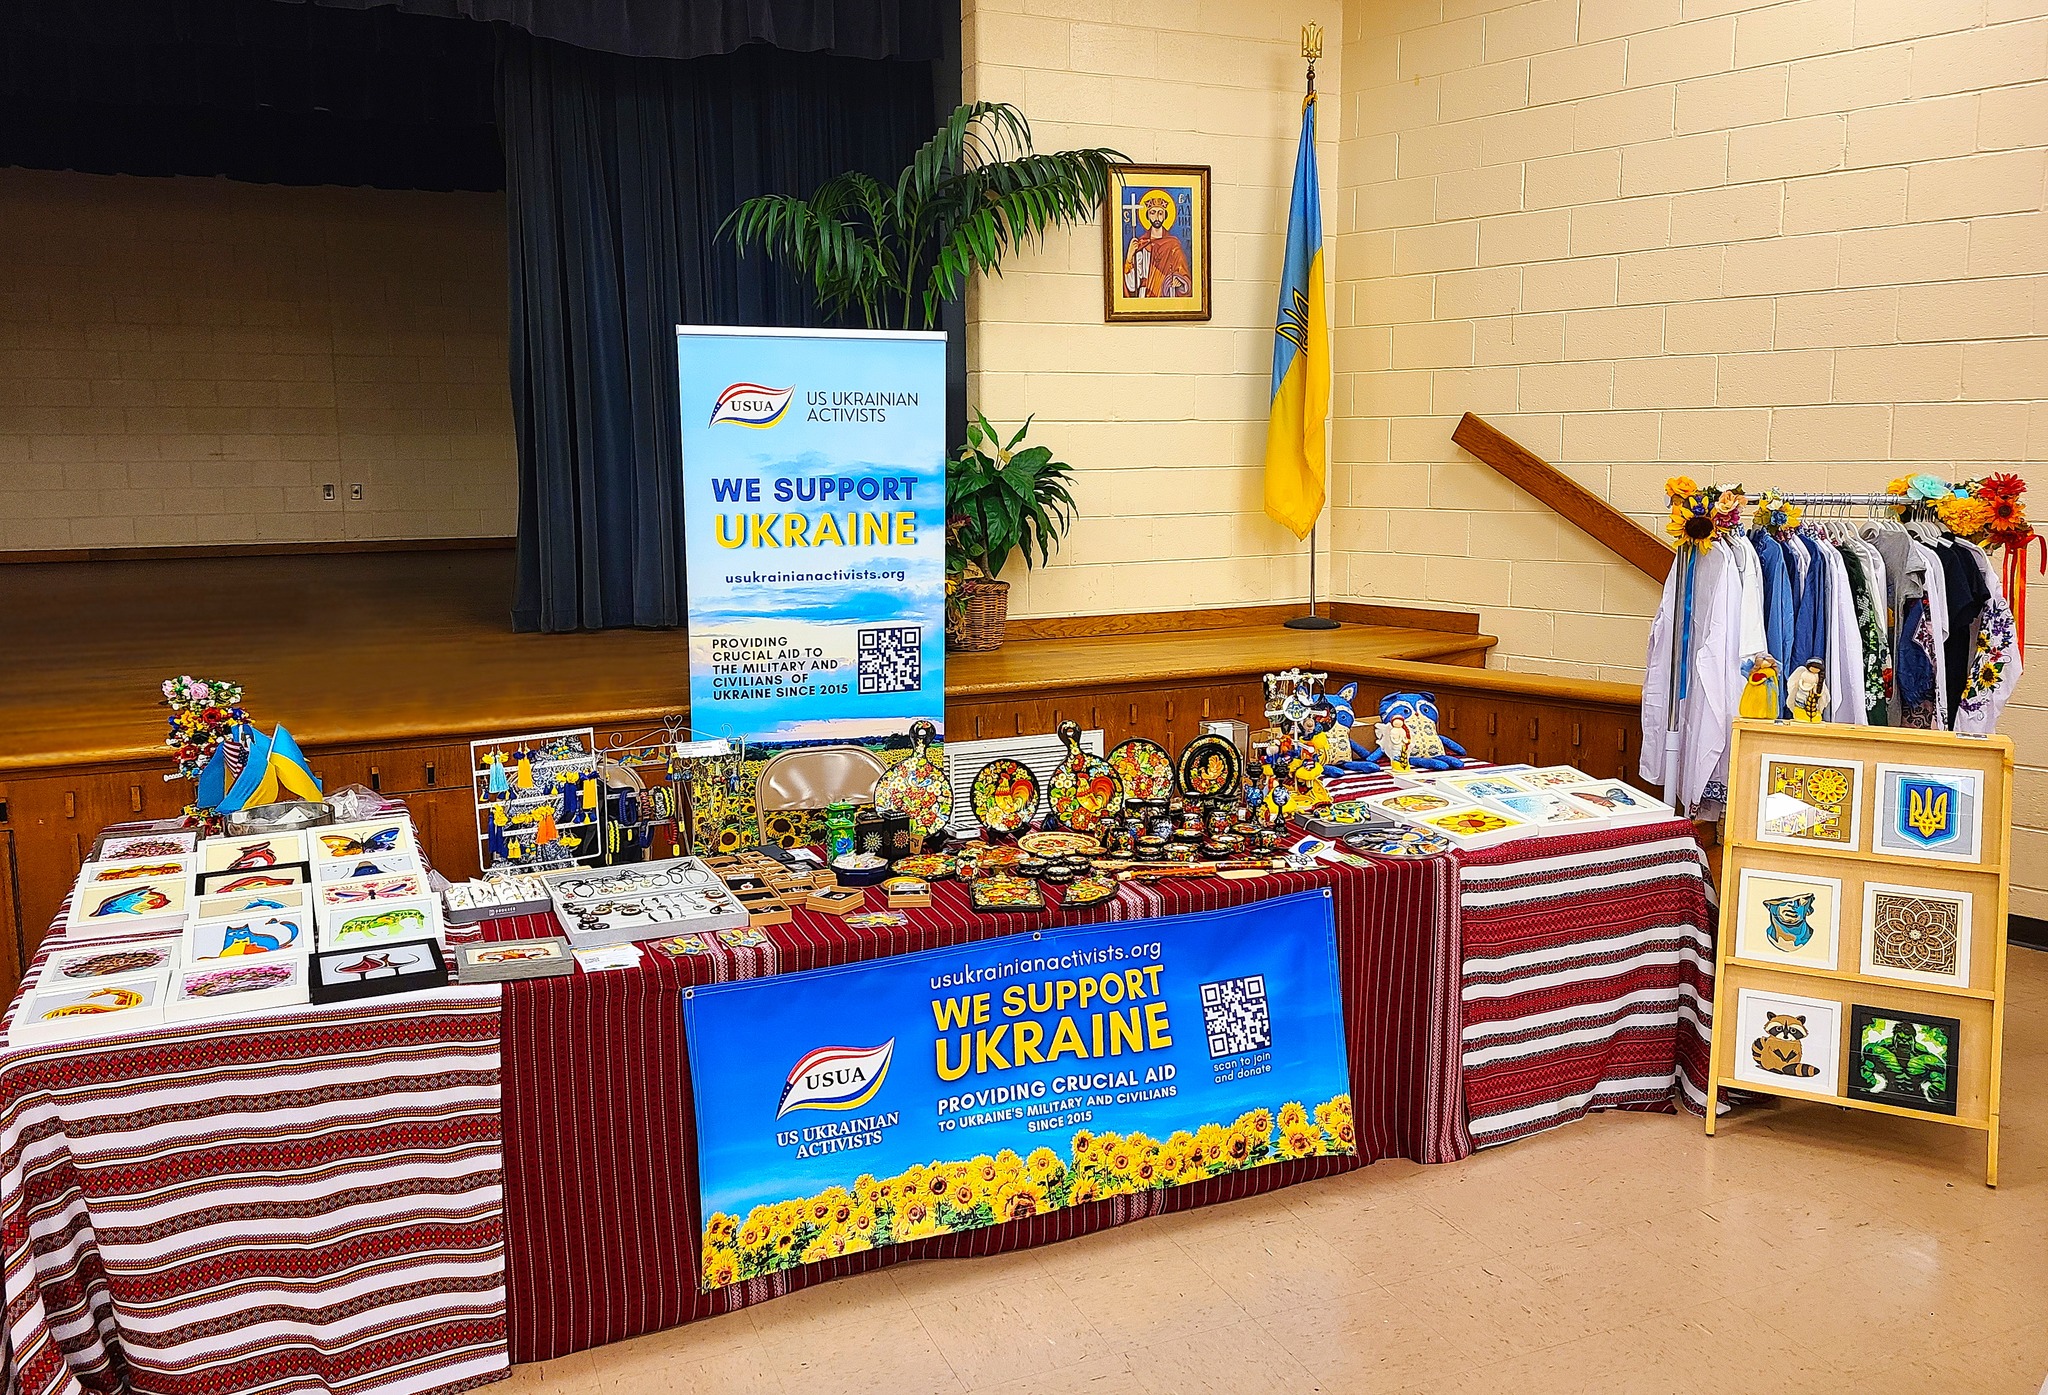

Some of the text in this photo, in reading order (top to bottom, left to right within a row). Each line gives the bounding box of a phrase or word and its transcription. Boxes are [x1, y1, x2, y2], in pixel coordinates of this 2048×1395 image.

[731, 400, 774, 412] USUA
[807, 392, 918, 406] US UKRAINIAN
[807, 408, 886, 422] ACTIVISTS
[712, 477, 918, 502] WE SUPPORT
[715, 512, 917, 548] UKRAINE
[726, 569, 905, 583] usukrainianactivists.org
[712, 636, 788, 648] PROVIDING
[712, 648, 822, 661] CRUCIAL AID TO
[712, 660, 838, 674] THE MILITARY AND
[713, 674, 808, 687] CIVILIANS OF
[713, 684, 848, 700] UKRAINE SINCE 2015
[930, 942, 1161, 989] usukrainianactivists.org
[932, 964, 1164, 1031] WE SUPPORT
[936, 1001, 1172, 1081] UKRAINE
[1213, 1053, 1271, 1072] scan to join
[805, 1066, 866, 1090] USUA
[1215, 1064, 1271, 1084] and donate
[938, 1064, 1176, 1115] PROVIDING CRUCIAL AID
[938, 1085, 1177, 1132] TO UKRAINE'S MILITARY AND CIVILIANS
[776, 1112, 899, 1146] US UKRAINIAN
[1028, 1110, 1093, 1133] SINCE 2015
[796, 1131, 882, 1159] ACTIVISTS
